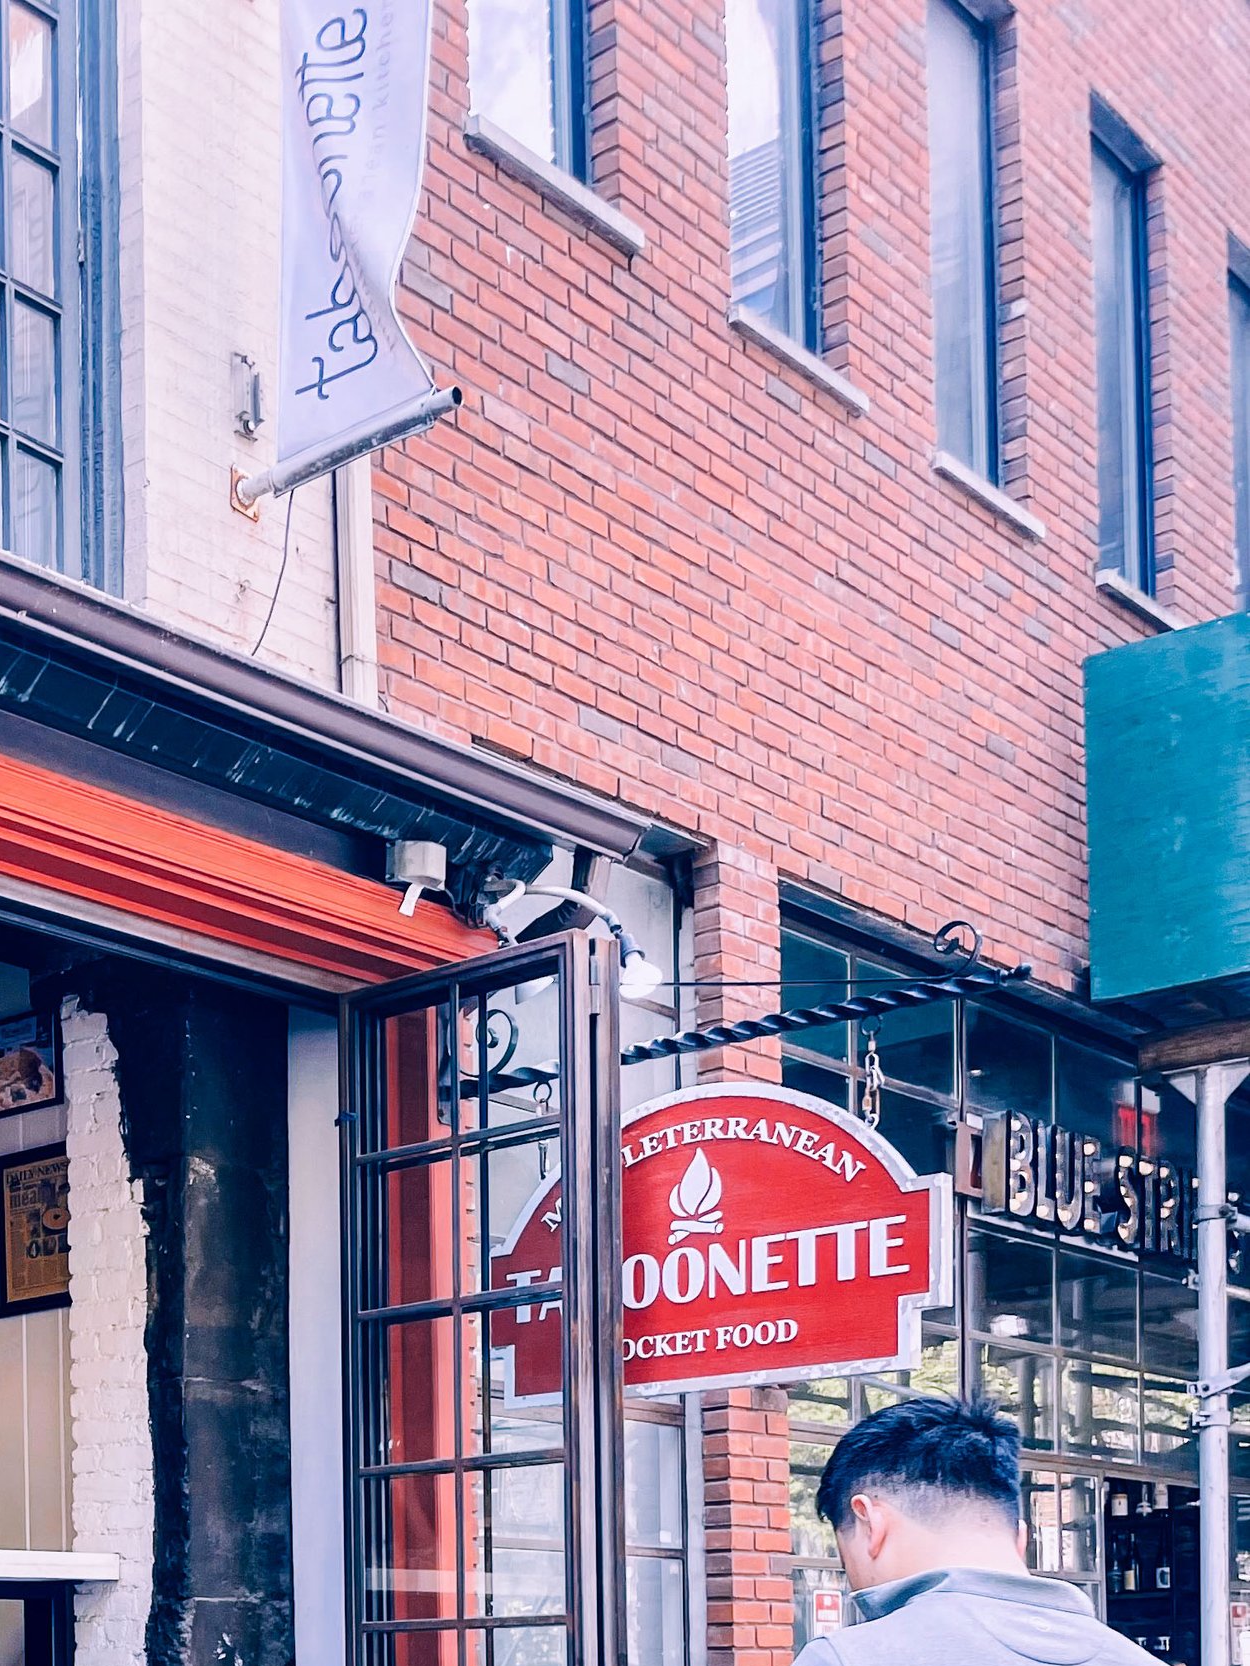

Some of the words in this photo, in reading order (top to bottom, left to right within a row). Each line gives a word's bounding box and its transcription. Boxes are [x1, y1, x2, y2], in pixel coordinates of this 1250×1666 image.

[1007, 1109, 1101, 1233] BLUE
[506, 1214, 910, 1324] TAOONETTE
[623, 1328, 710, 1361] OCKET
[716, 1319, 798, 1350] FOOD
